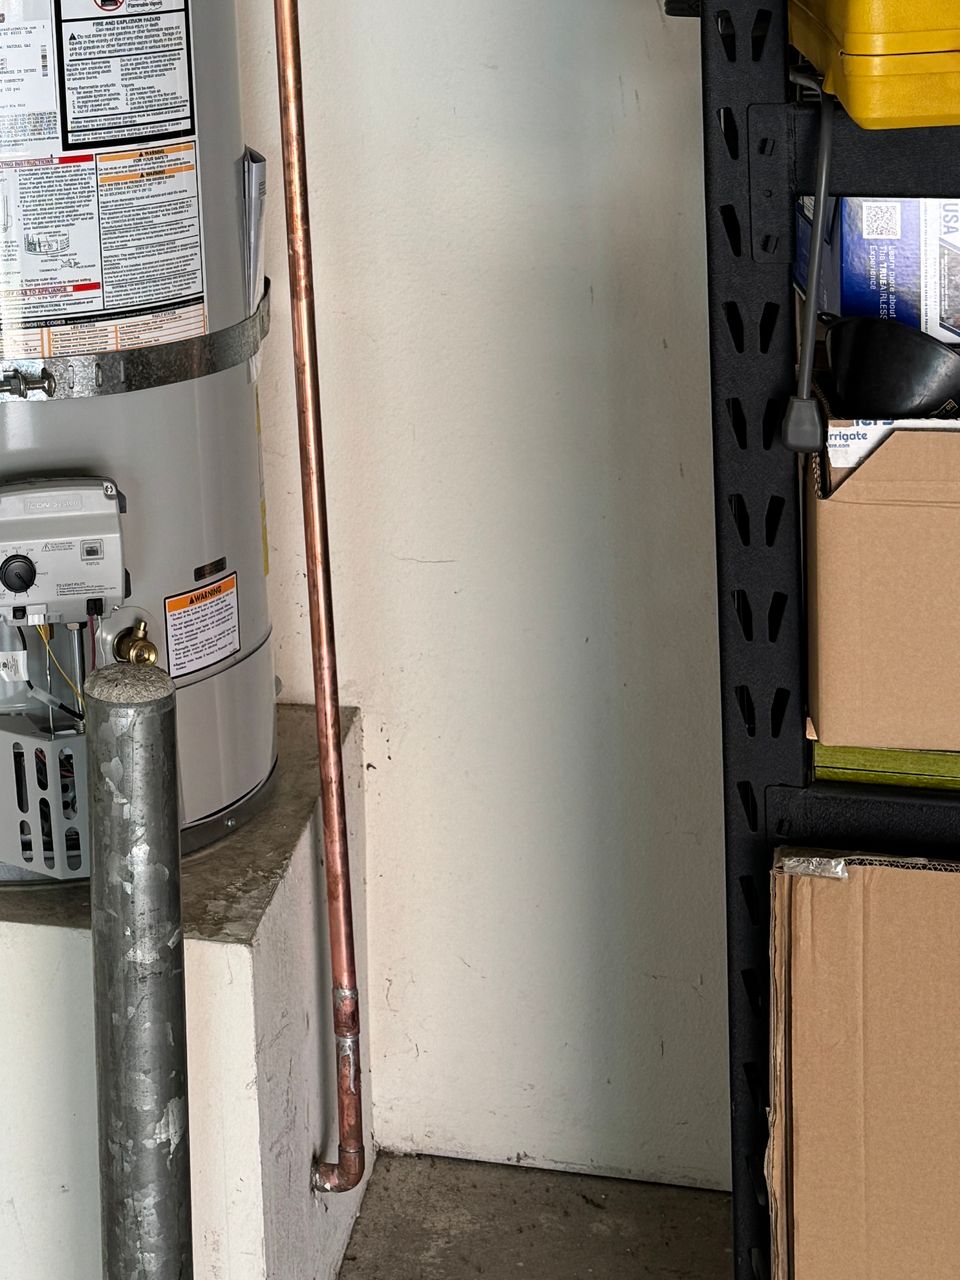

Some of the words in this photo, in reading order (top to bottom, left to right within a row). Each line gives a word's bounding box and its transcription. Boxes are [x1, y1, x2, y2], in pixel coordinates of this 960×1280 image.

[942, 203, 959, 235] USA
[879, 245, 887, 260] The
[888, 246, 896, 269] Learn
[869, 245, 877, 290] Experience
[889, 295, 897, 318] about
[194, 586, 222, 603] WARNING
